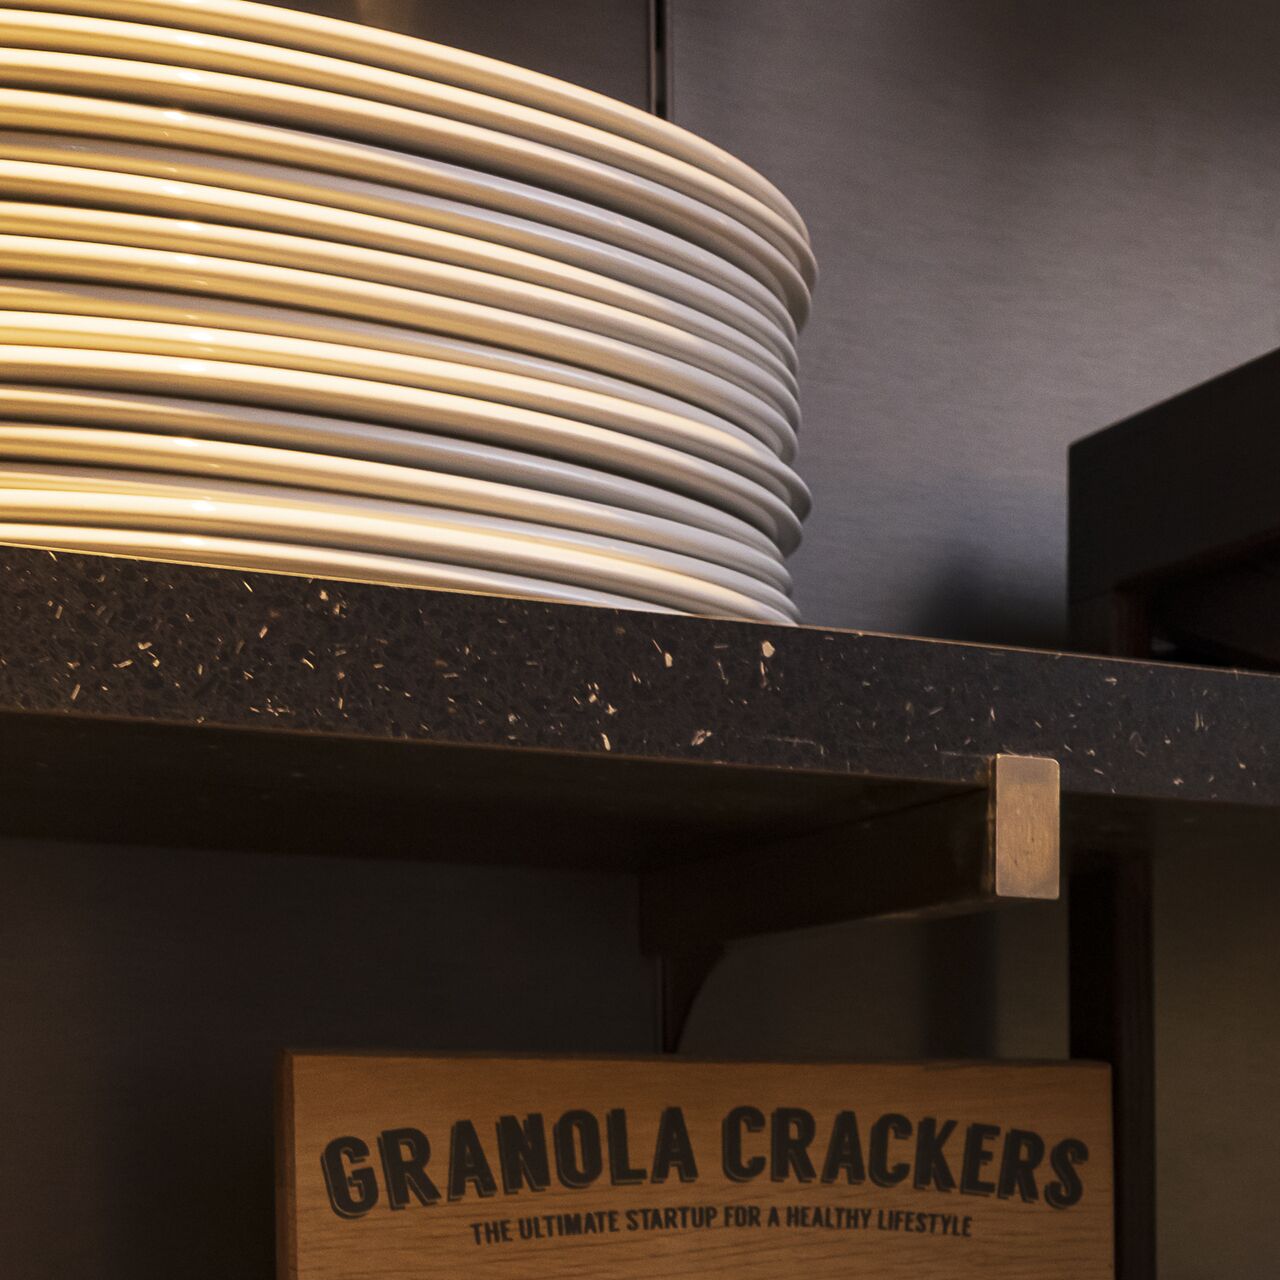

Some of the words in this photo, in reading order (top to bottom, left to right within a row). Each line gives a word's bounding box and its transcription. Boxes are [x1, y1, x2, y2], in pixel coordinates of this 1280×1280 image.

[320, 1106, 698, 1219] GRANOLA
[721, 1105, 1090, 1210] CRACKERS
[470, 1219, 514, 1246] THE
[519, 1211, 622, 1240] ULTIMATE
[626, 1206, 718, 1233] STARTUP
[723, 1205, 762, 1229] FOR
[766, 1206, 781, 1227] A
[786, 1206, 873, 1231] HEALTHY
[877, 1209, 973, 1238] LIFESTYLE
